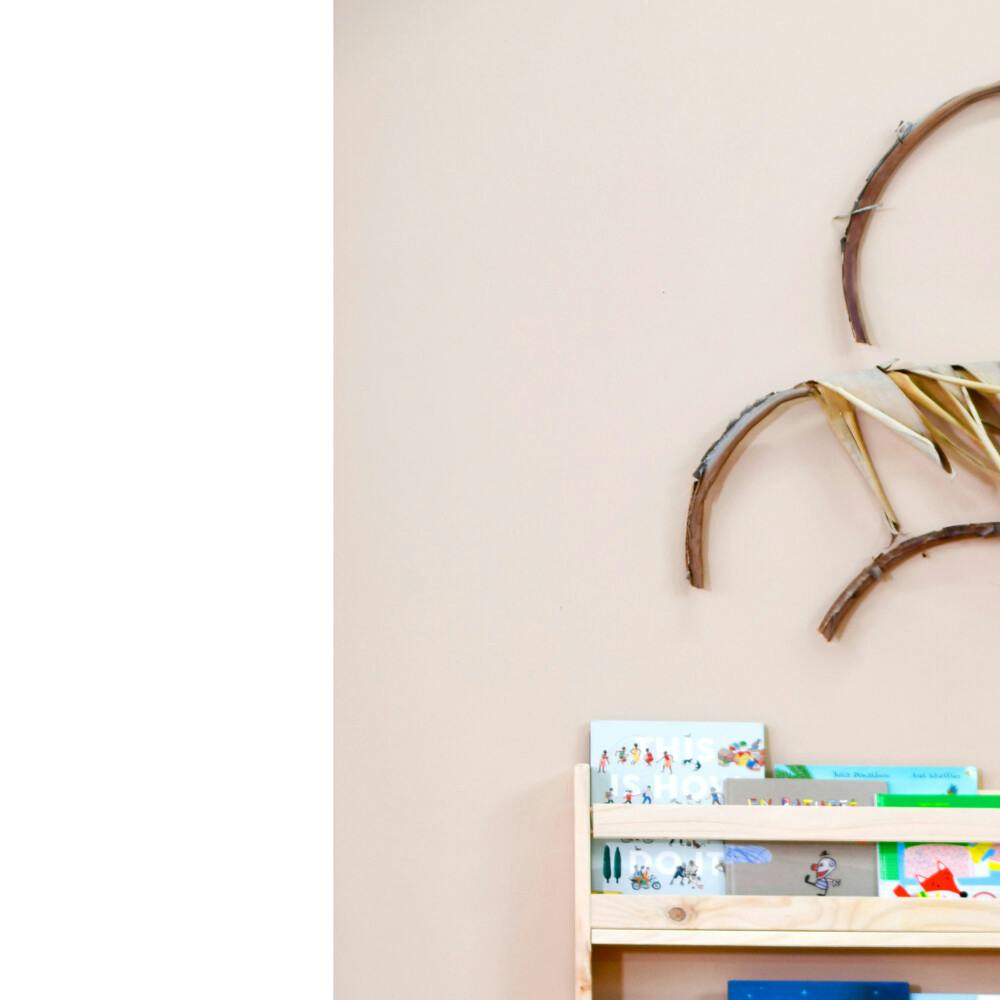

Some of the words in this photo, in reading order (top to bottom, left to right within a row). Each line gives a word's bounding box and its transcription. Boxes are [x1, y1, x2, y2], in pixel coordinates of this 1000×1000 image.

[635, 737, 714, 763] THIS
[611, 774, 641, 798] IS
[629, 851, 681, 877] DO
[695, 851, 724, 876] IT
